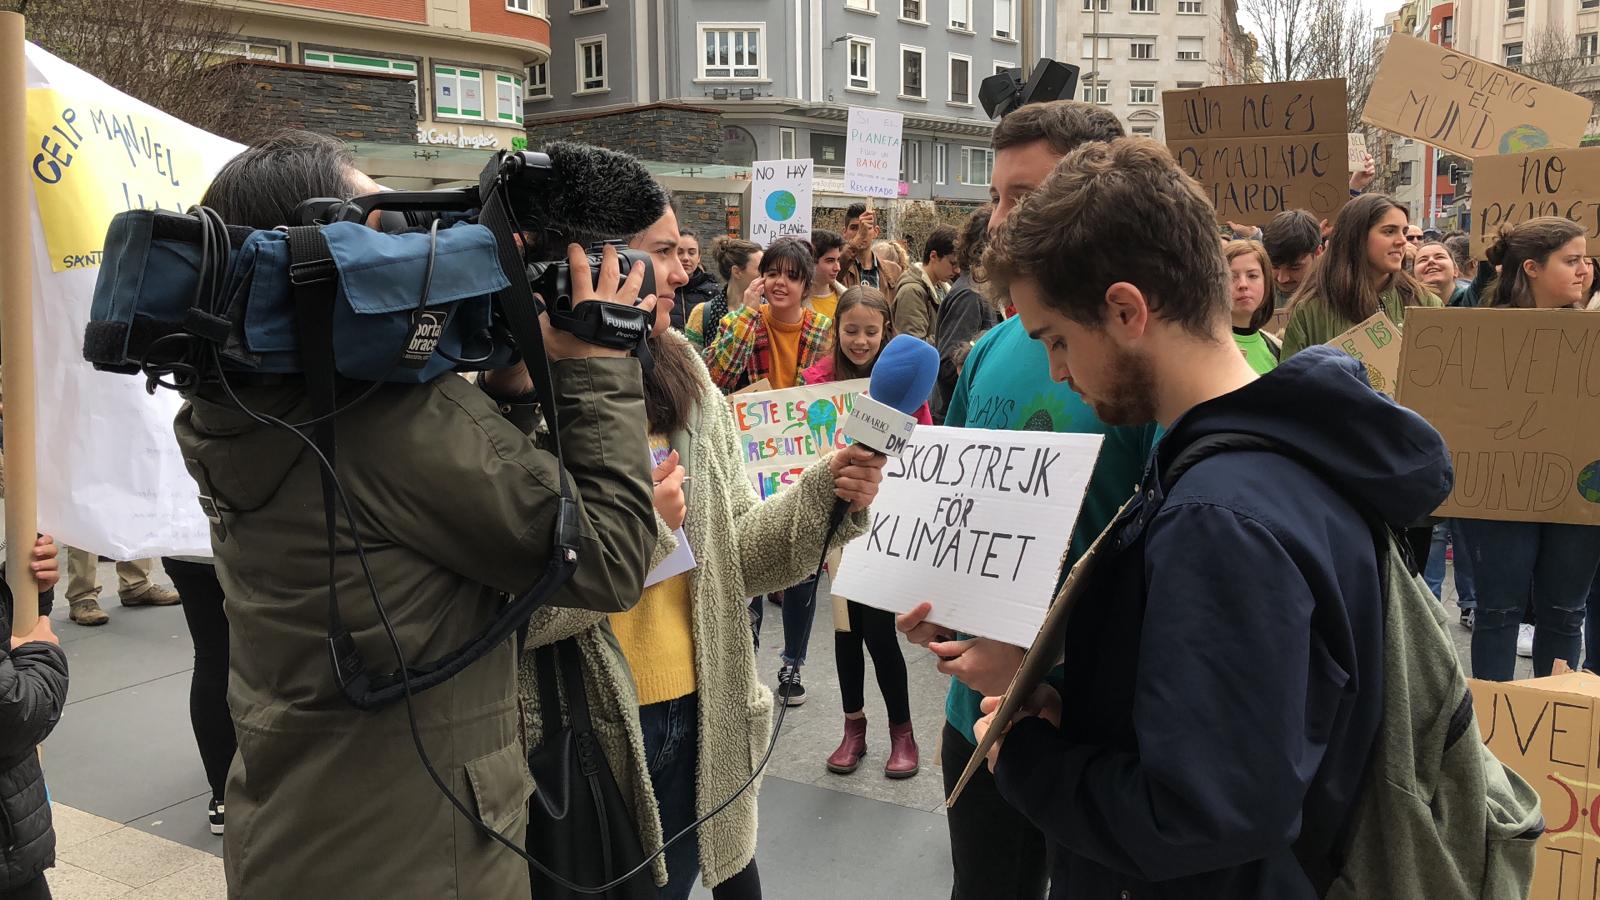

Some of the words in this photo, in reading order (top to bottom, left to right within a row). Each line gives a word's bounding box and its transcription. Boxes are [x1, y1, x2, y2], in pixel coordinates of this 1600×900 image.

[1441, 54, 1538, 108] SALVEMOS
[1469, 92, 1492, 113] EL
[1398, 90, 1495, 149] MUND
[33, 108, 83, 184] CEIP
[90, 109, 179, 186] MANUEL
[428, 128, 457, 144] Corte
[851, 129, 900, 146] PLANETA
[755, 167, 775, 181] NO
[787, 165, 808, 179] HAY
[857, 158, 888, 169] BANCO
[1178, 142, 1331, 179] DEMASIADO
[850, 181, 894, 195] RESCATADO
[753, 223, 767, 235] UN
[606, 317, 642, 332] FUJINON
[1365, 321, 1392, 349] IS
[408, 338, 439, 351] brace
[736, 400, 780, 431] ESTE
[786, 400, 808, 422] ES
[850, 408, 860, 418] EL
[861, 412, 889, 432] DIARIO
[1486, 400, 1547, 440] el
[740, 434, 816, 464] PRESENTE
[885, 433, 907, 454] DM
[887, 443, 1061, 497] SKOLSTREJK
[1440, 451, 1574, 513] UND
[933, 493, 975, 528] FÖR
[866, 512, 1036, 582] KLIMATET
